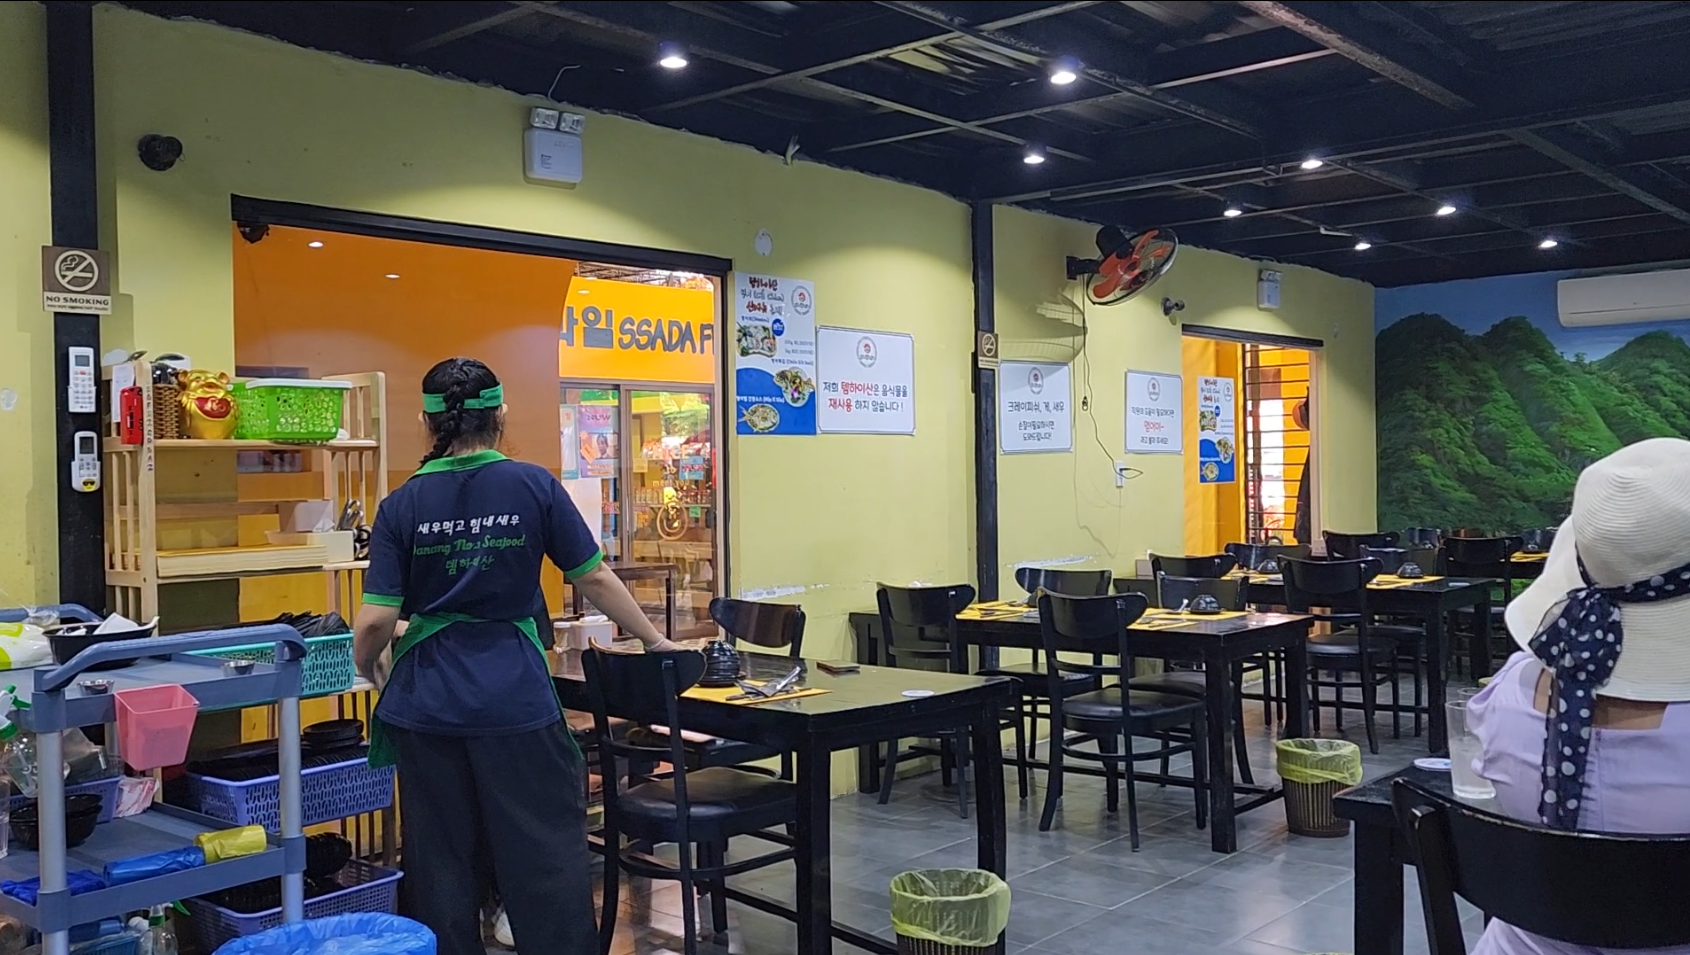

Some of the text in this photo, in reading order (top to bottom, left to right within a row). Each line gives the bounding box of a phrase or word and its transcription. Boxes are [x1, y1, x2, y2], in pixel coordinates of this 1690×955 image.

[45, 295, 109, 306] NO SMOKING
[618, 316, 714, 355] SSADA F
[822, 381, 908, 398] 저희 템하이산은 음식물을
[828, 398, 853, 413] 재사용
[854, 399, 870, 411] 하지
[417, 514, 520, 536] 새우먹고 힘내새우
[482, 534, 526, 550] Seafood
